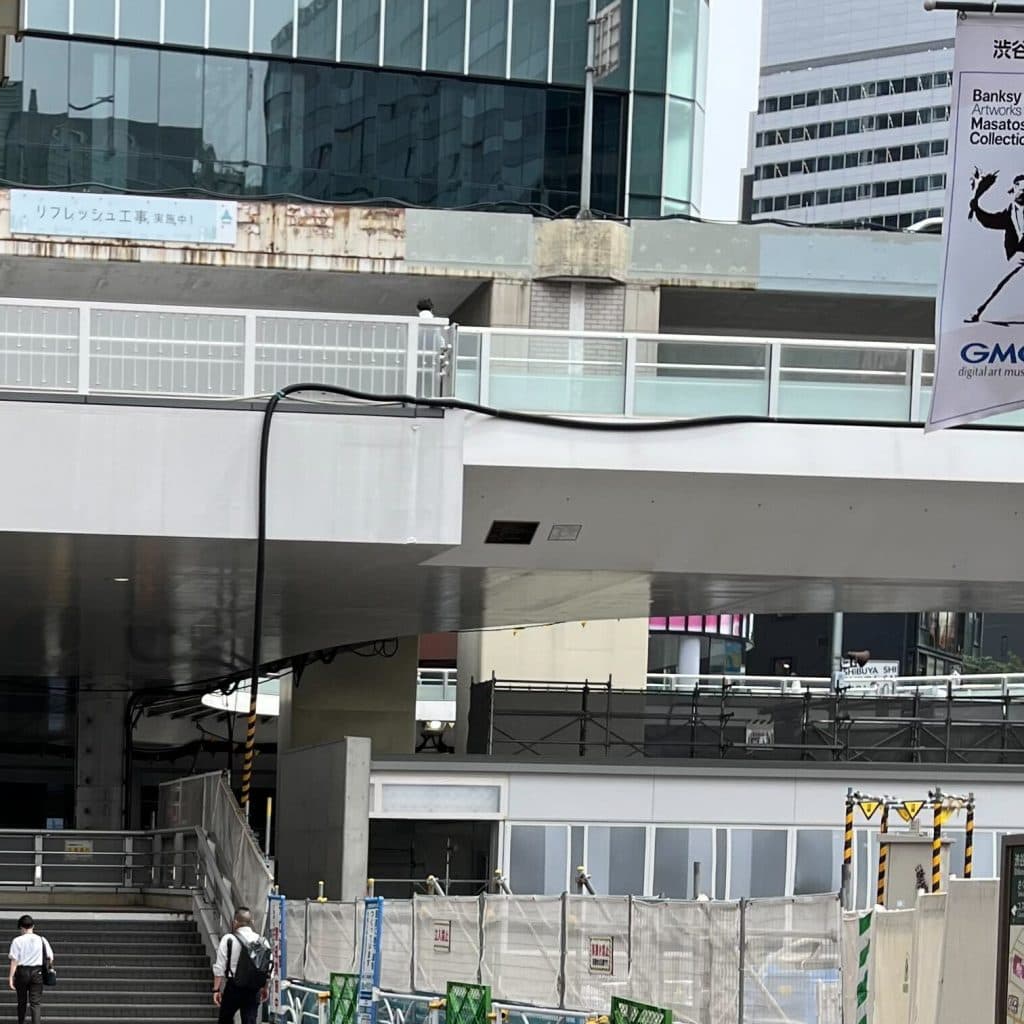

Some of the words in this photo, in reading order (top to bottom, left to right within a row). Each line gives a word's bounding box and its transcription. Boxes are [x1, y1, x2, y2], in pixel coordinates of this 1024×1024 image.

[973, 88, 1022, 106] Banksy
[971, 103, 1022, 116] Artworks
[960, 342, 1024, 364] GM
[958, 365, 987, 380] digital
[988, 367, 1002, 377] art
